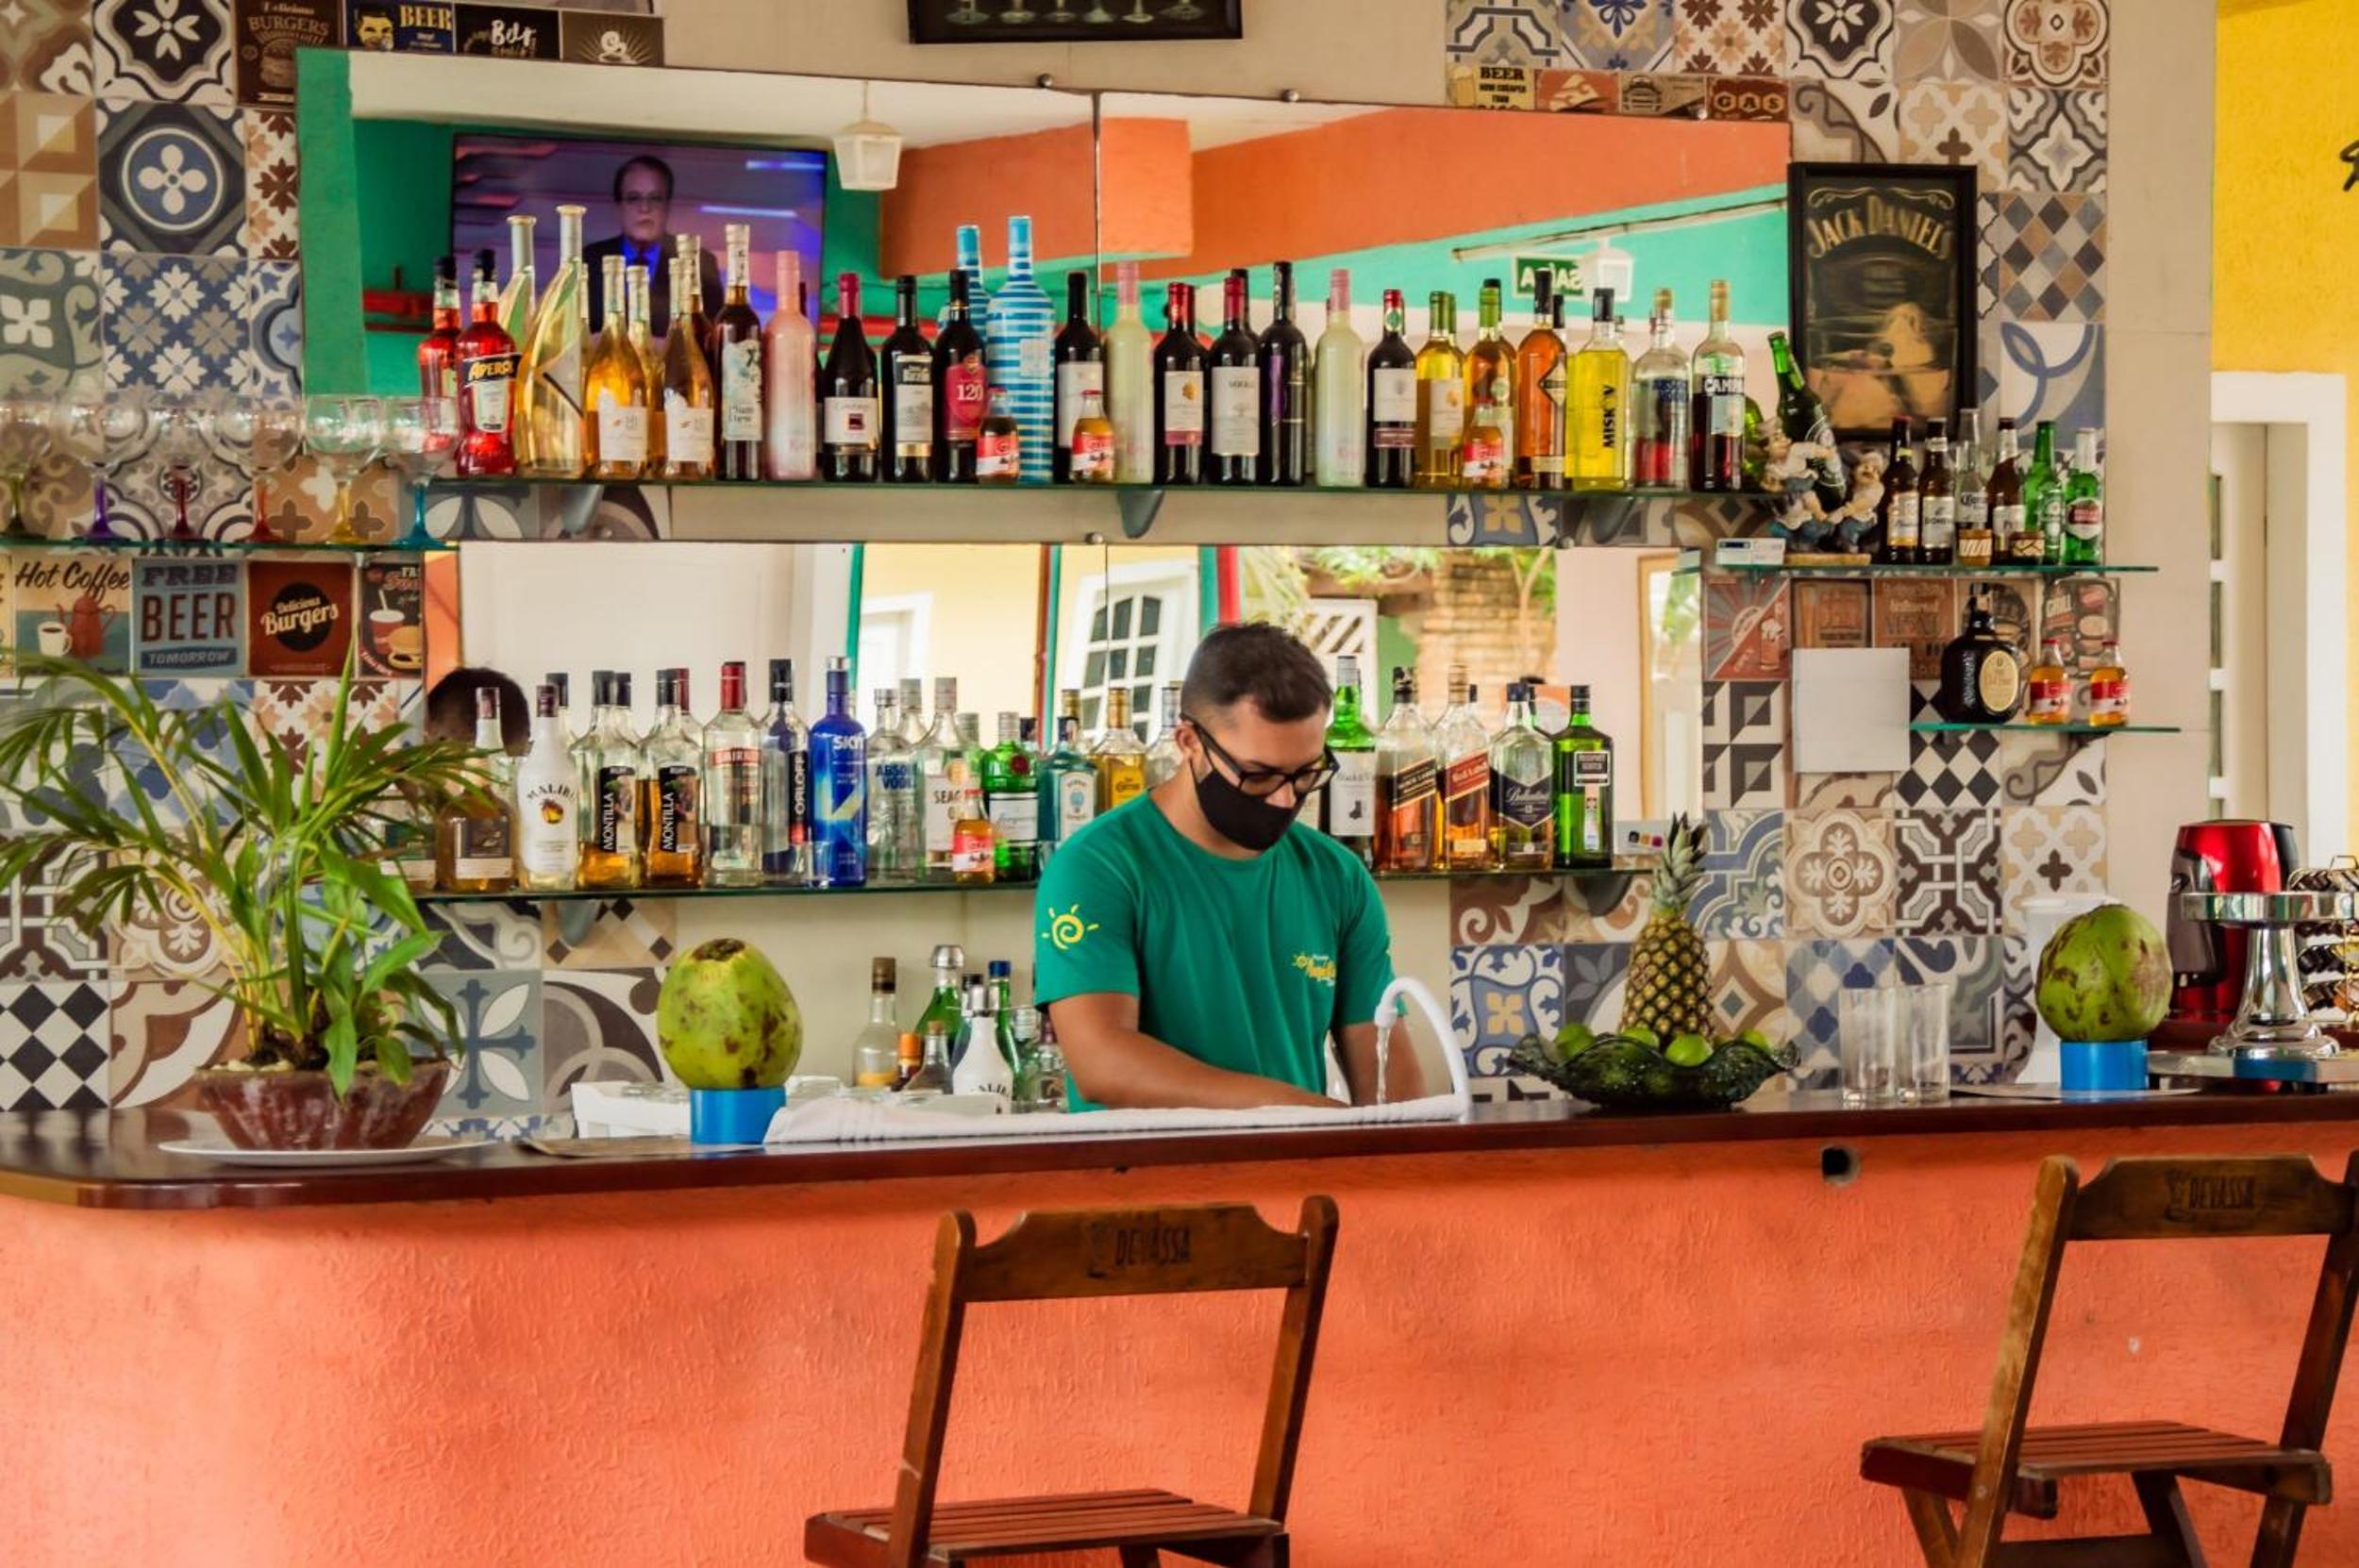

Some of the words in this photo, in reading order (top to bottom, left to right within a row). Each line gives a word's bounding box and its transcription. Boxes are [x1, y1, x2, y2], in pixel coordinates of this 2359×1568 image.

[248, 15, 330, 36] BURGERS
[399, 5, 452, 30] BEER
[1480, 67, 1525, 81] BEER
[1717, 95, 1781, 109] GAS
[1807, 207, 1865, 259] JACK
[956, 383, 984, 401] 120
[17, 560, 59, 588] Hot
[63, 560, 131, 605] Coffee
[141, 564, 237, 587] FREE
[142, 592, 236, 642] BEER
[259, 603, 340, 637] Burgers
[149, 650, 230, 665] TOMORROW
[602, 792, 615, 851] MONTILLA
[662, 792, 675, 851] MONTILLA
